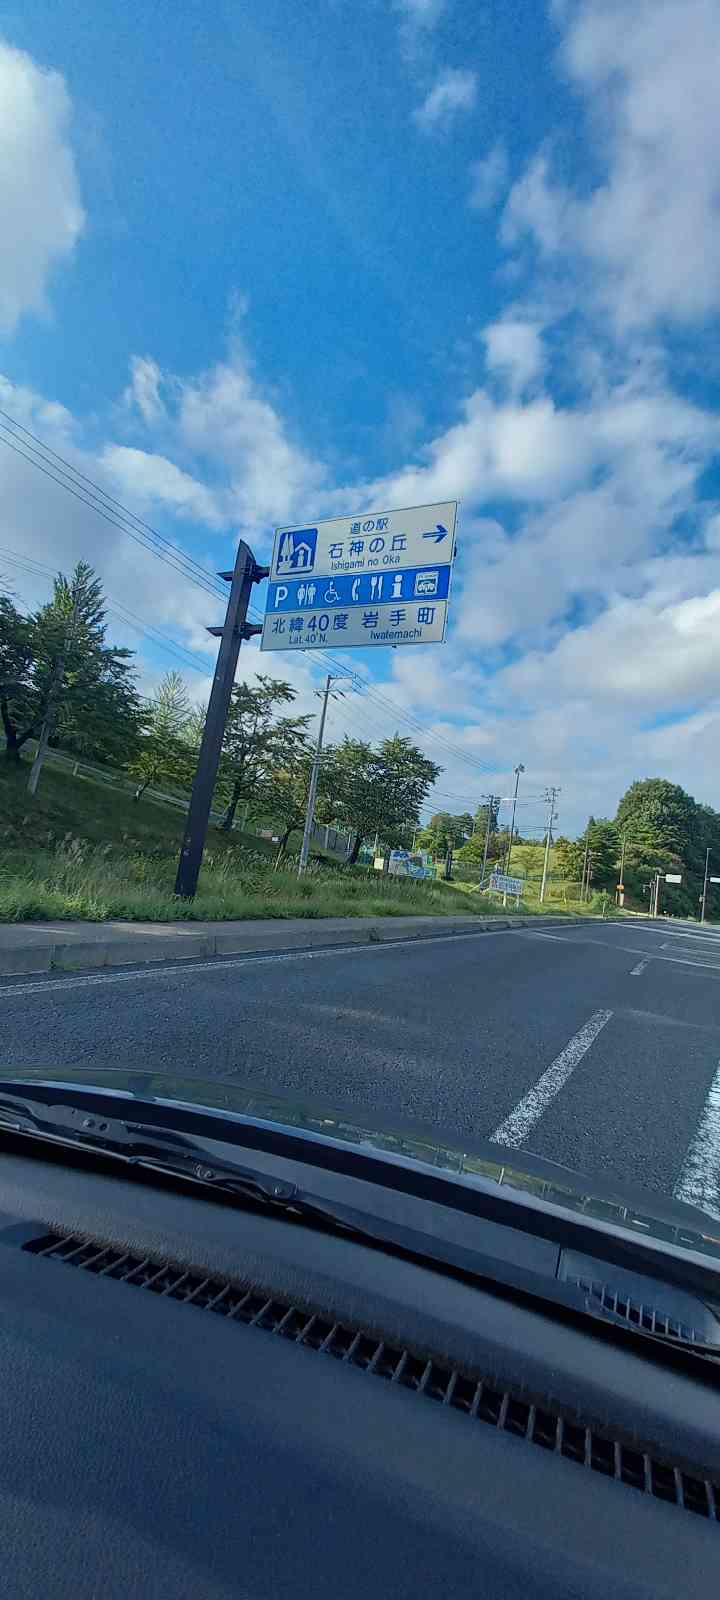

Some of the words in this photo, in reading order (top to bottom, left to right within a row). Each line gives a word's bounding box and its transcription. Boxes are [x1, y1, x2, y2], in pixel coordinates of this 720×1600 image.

[350, 517, 389, 534] 道の駅
[328, 534, 407, 559] 石神の丘
[331, 559, 365, 570] Ishigami
[382, 554, 401, 565] Oka
[274, 586, 288, 608] P
[272, 614, 349, 634] 北緯40度
[361, 607, 436, 629] 岩手町
[370, 628, 422, 639] Iwatemachi
